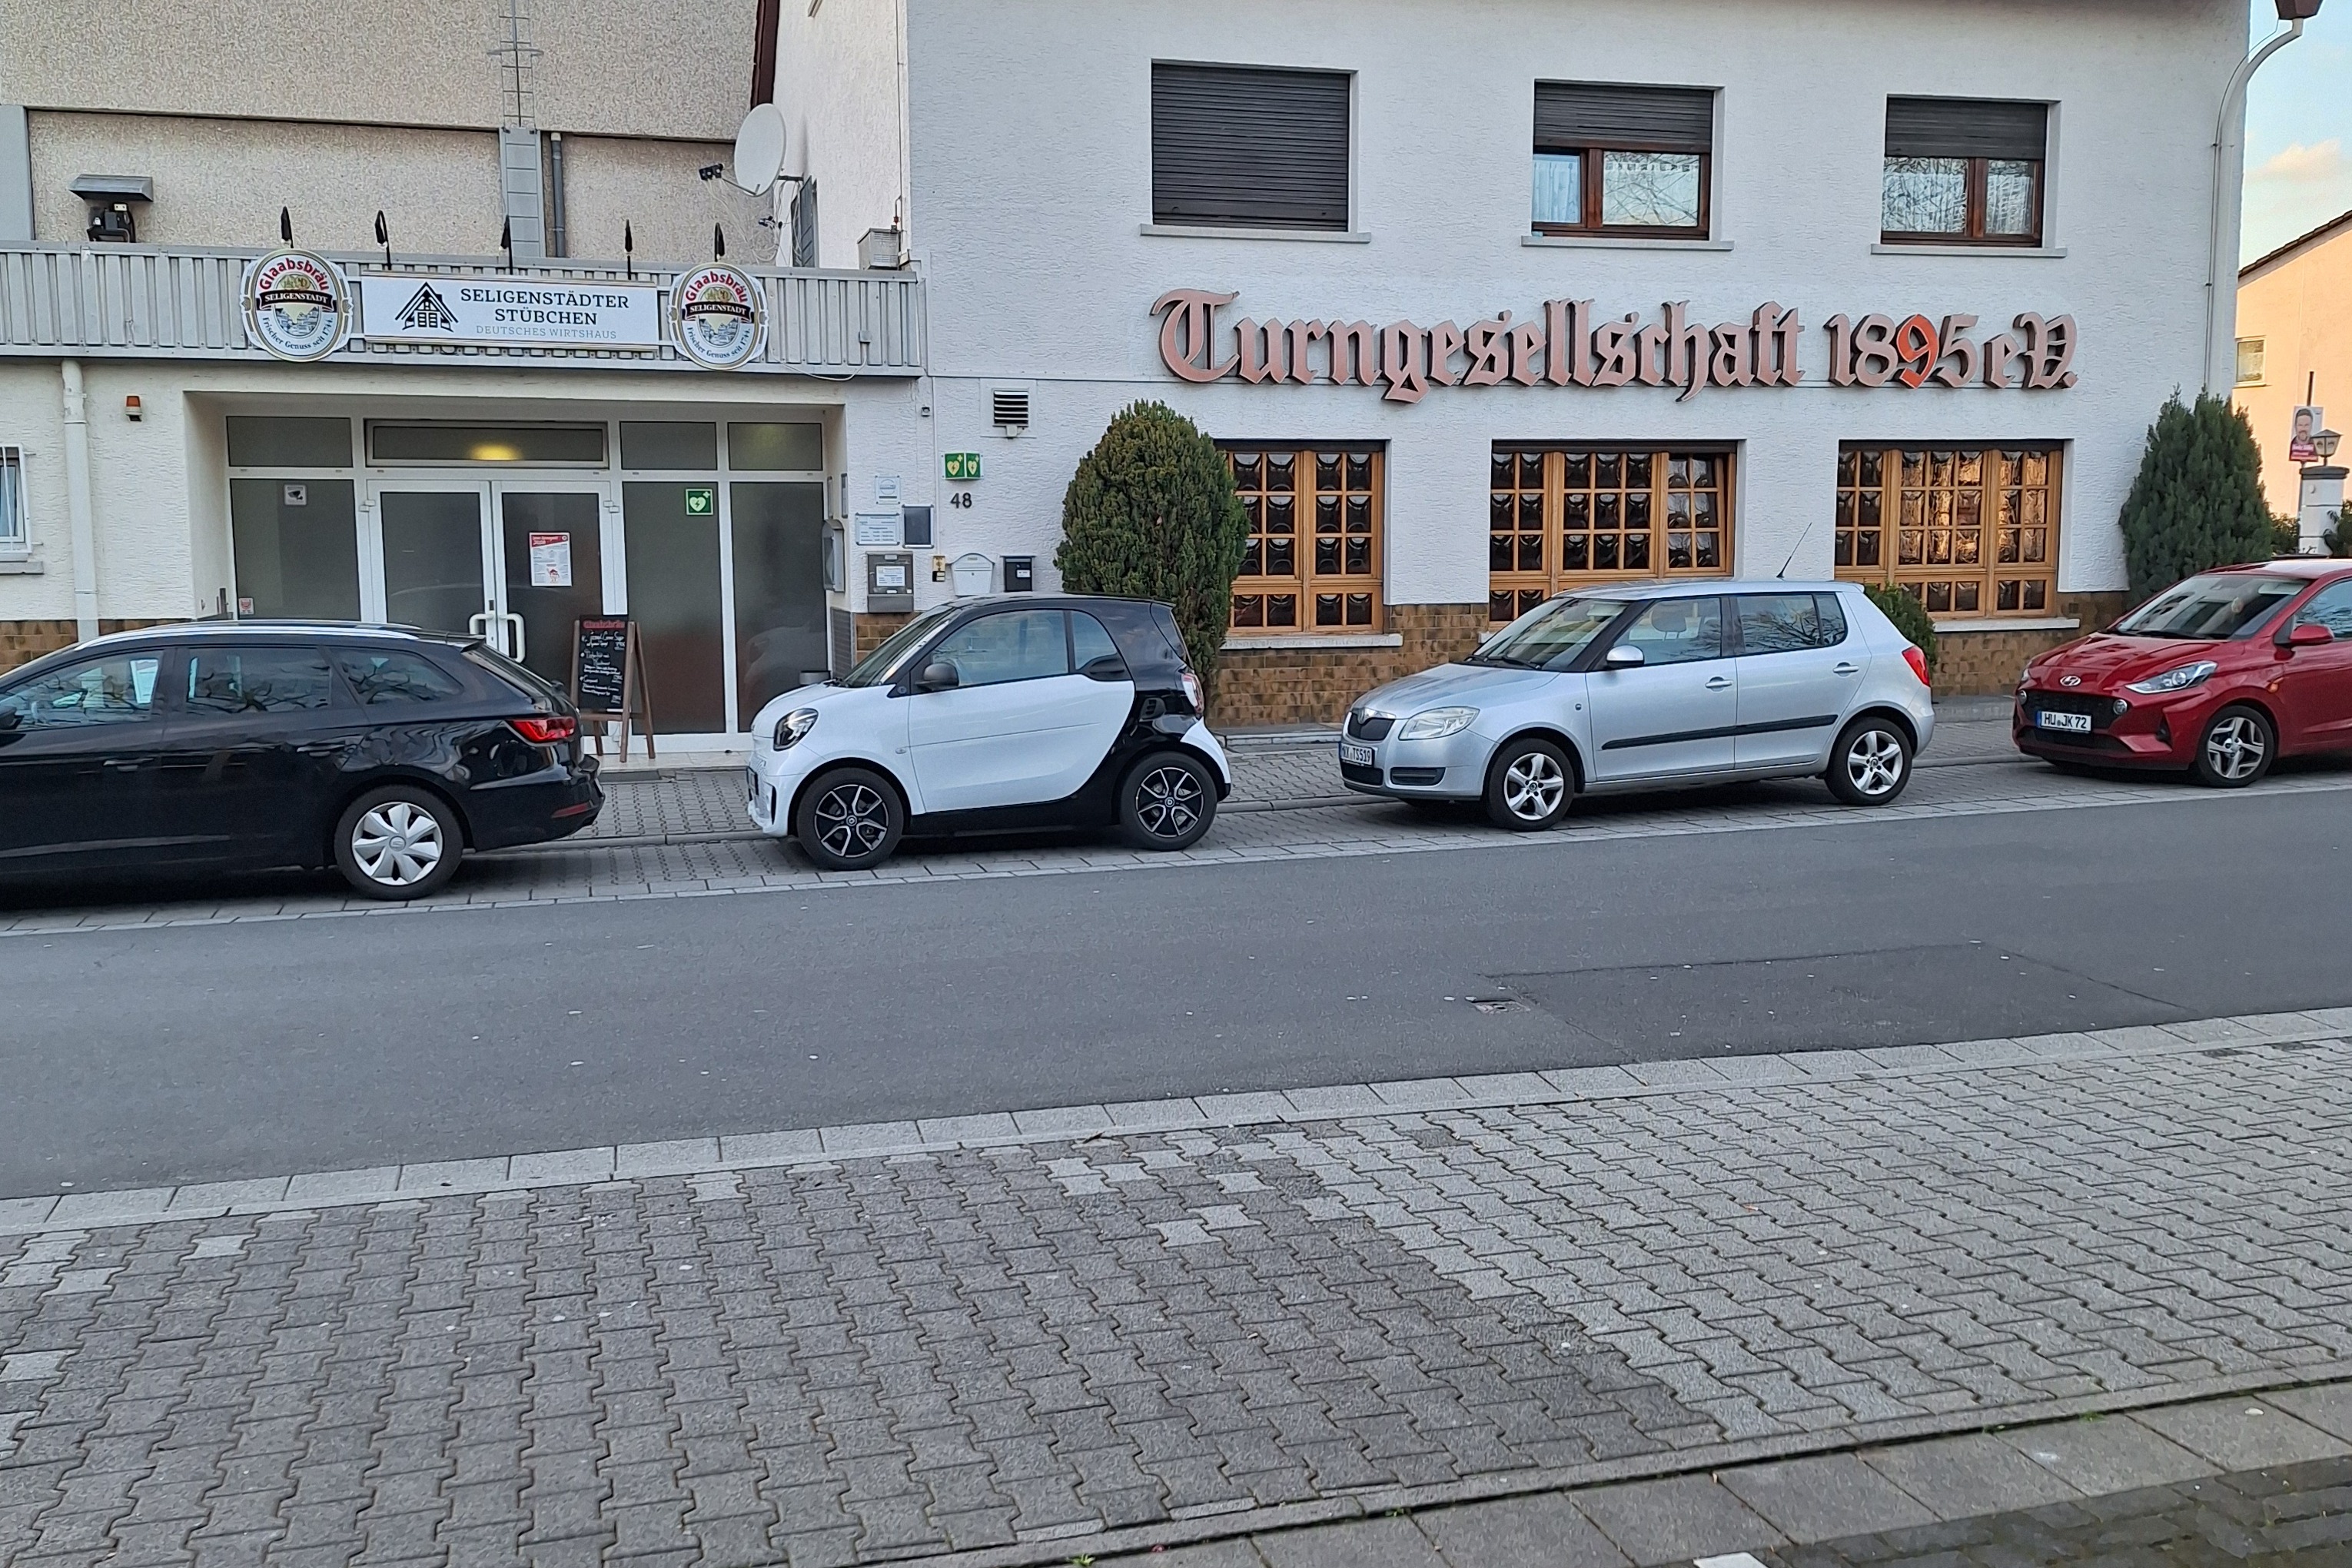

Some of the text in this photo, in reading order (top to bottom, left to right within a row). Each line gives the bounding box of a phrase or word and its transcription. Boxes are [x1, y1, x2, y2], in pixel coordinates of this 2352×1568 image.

[259, 257, 330, 291] Glaabsbräu
[685, 271, 748, 303] Glaabsbräu
[264, 292, 328, 304] SELIGENSTADT
[460, 288, 630, 308] SELIGENSTÄDTER
[495, 307, 598, 325] STÜBCHEN
[689, 304, 747, 315] SELIGENSTADT
[262, 317, 284, 344] Frischer
[285, 341, 312, 350] Genuss
[312, 335, 325, 347] seit
[476, 325, 617, 340] DEUTSCHES WIRTSHAUS
[687, 327, 706, 354] Frischer
[706, 350, 731, 359] Genuss
[730, 345, 743, 356] seit
[1149, 287, 1806, 404] Turngesellschaft
[1823, 313, 1979, 390] 1895
[950, 492, 973, 509] 48
[2045, 713, 2087, 729] HU JK 72
